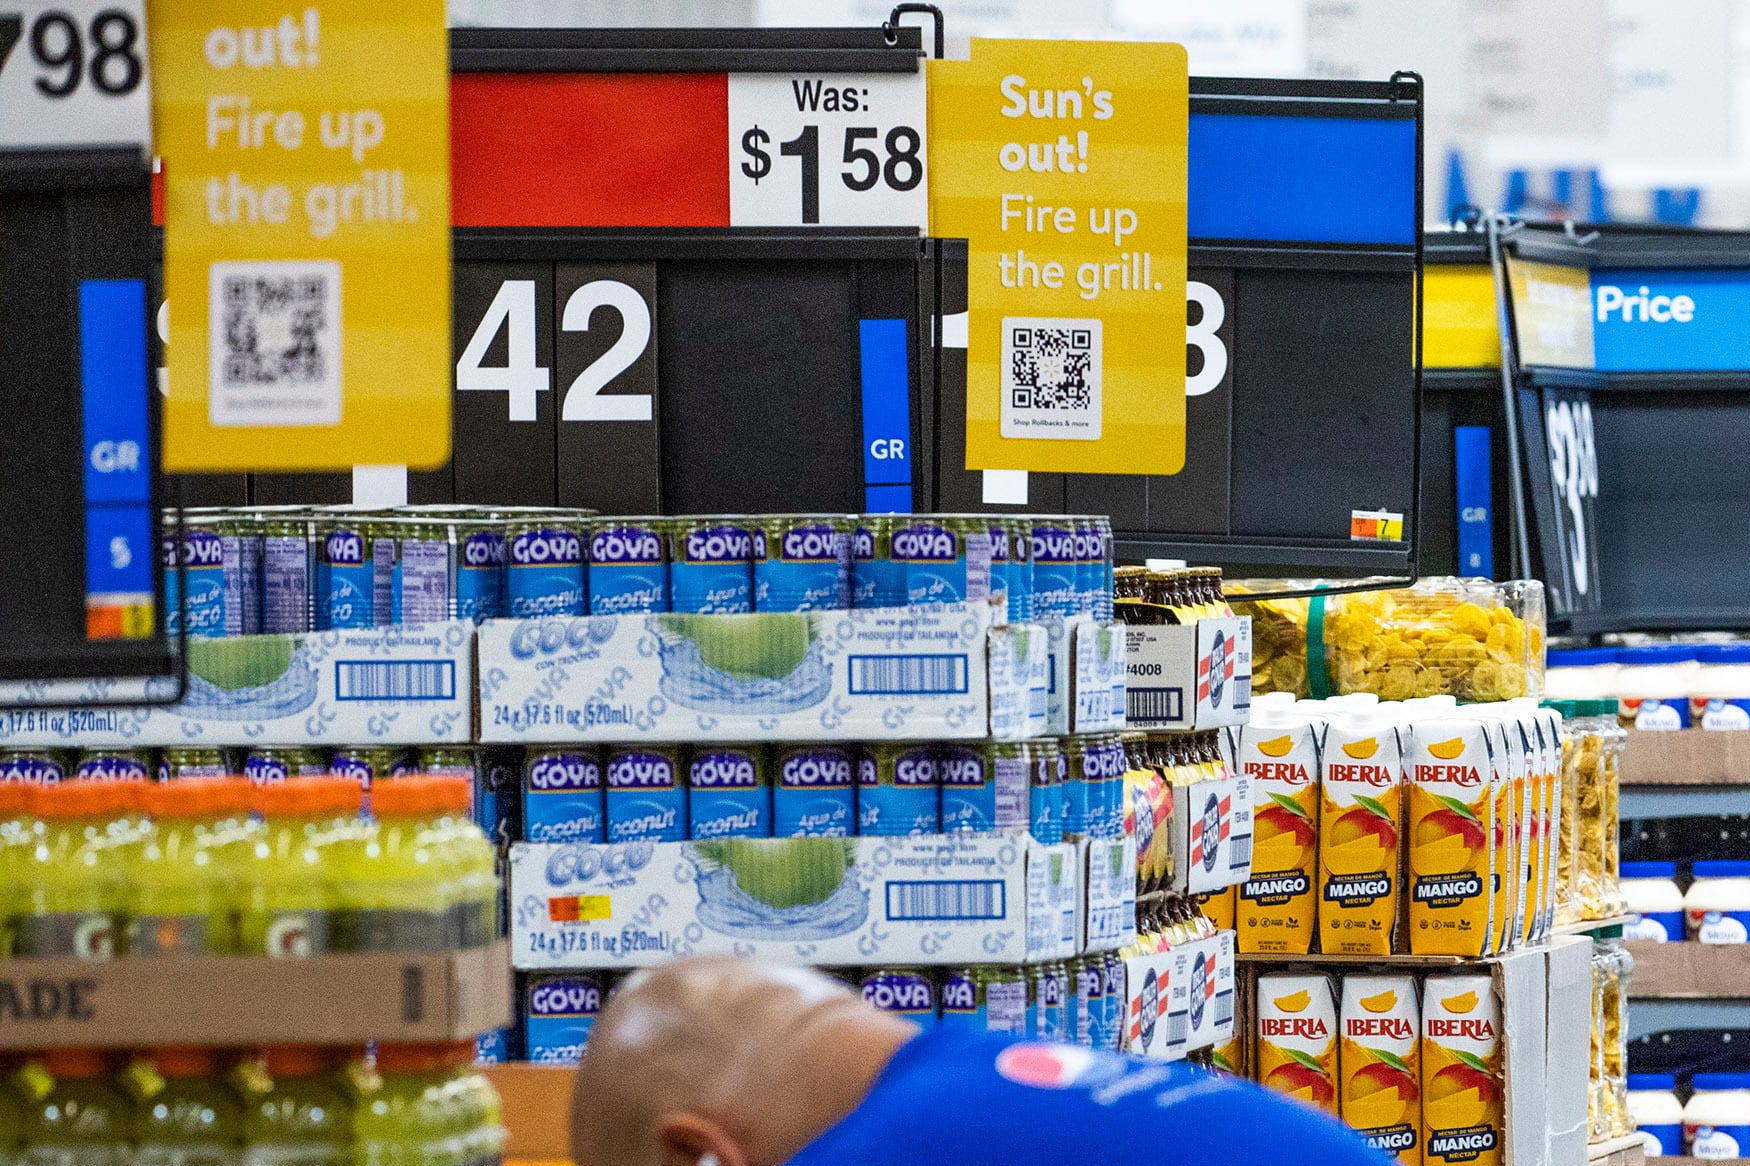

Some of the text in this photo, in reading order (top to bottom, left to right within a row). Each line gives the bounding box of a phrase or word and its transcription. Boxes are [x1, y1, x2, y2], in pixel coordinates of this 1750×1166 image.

[205, 8, 320, 68] out!
[792, 79, 870, 112] Was:
[999, 75, 1114, 121] Sun's
[206, 97, 385, 163] Fire up
[999, 132, 1088, 174] out!
[205, 170, 419, 237] the grill.
[1000, 194, 1137, 243] Fire up
[999, 254, 1162, 298] the grill.
[1597, 285, 1696, 323] Price
[456, 280, 653, 421] 42
[1013, 419, 1030, 428] Shop
[1032, 419, 1063, 427] Rollbacks
[870, 440, 905, 460] GR
[1380, 518, 1389, 534] 7
[513, 535, 580, 562] GOYA
[592, 535, 660, 562] GOYA
[494, 705, 510, 724] 24
[606, 762, 671, 786] GOYA
[690, 762, 755, 786] GOYA
[1244, 762, 1309, 785] IBERIA
[1329, 764, 1392, 787] IBERIA
[1415, 765, 1481, 787] IBERIA
[1246, 879, 1306, 896] MANGO
[1329, 881, 1388, 898] MANGO
[1418, 881, 1478, 898] MANGO
[1261, 895, 1288, 903] NECTAR
[1345, 897, 1372, 905] NECTAR
[1432, 897, 1460, 905] NECTAR
[530, 932, 545, 951] 24
[1262, 1018, 1328, 1040] IBERIA
[1347, 1018, 1413, 1040] IBERIA
[1428, 1019, 1494, 1041] IBERIA
[1433, 1134, 1494, 1152] MANGO
[1449, 1151, 1477, 1159] NECTAR
